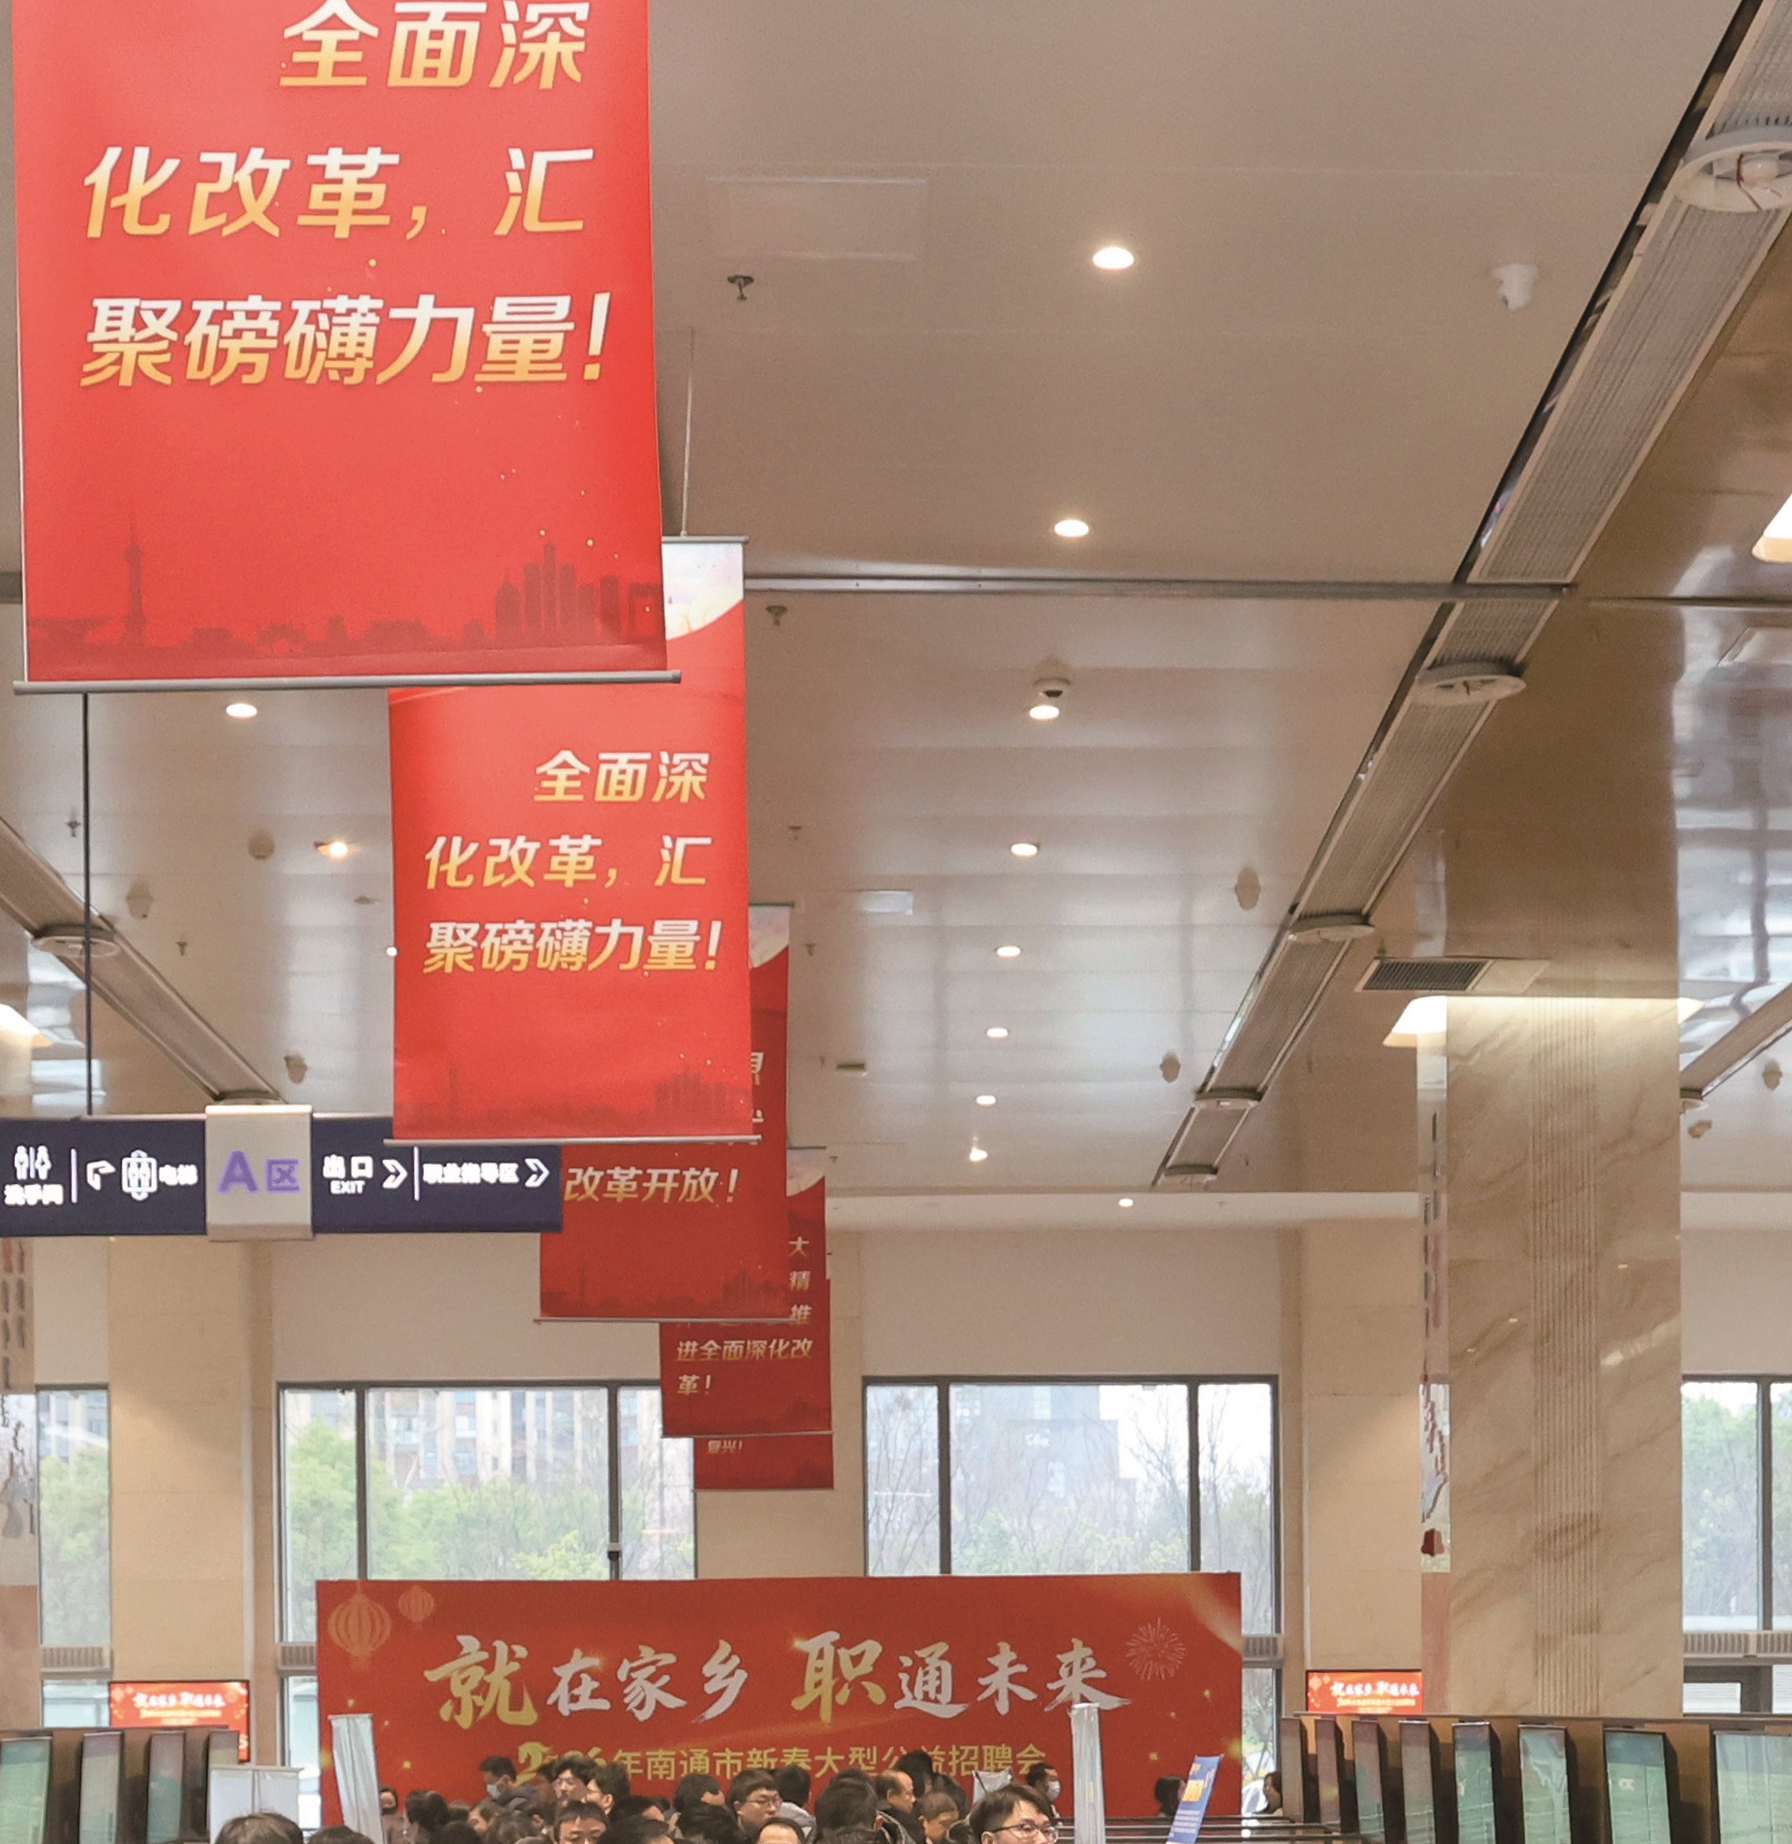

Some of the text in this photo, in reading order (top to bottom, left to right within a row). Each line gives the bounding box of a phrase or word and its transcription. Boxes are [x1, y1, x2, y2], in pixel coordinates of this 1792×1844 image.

[279, 0, 590, 89] 全面深
[83, 146, 593, 240] 化改革，汇
[533, 750, 710, 803] 全面深
[423, 834, 712, 890] 化改革，汇
[323, 1154, 373, 1179] 出口
[329, 1179, 366, 1194] EXIT
[564, 1167, 740, 1203] 改革开放！
[423, 1628, 1133, 1729] 就在家乡 职通未来
